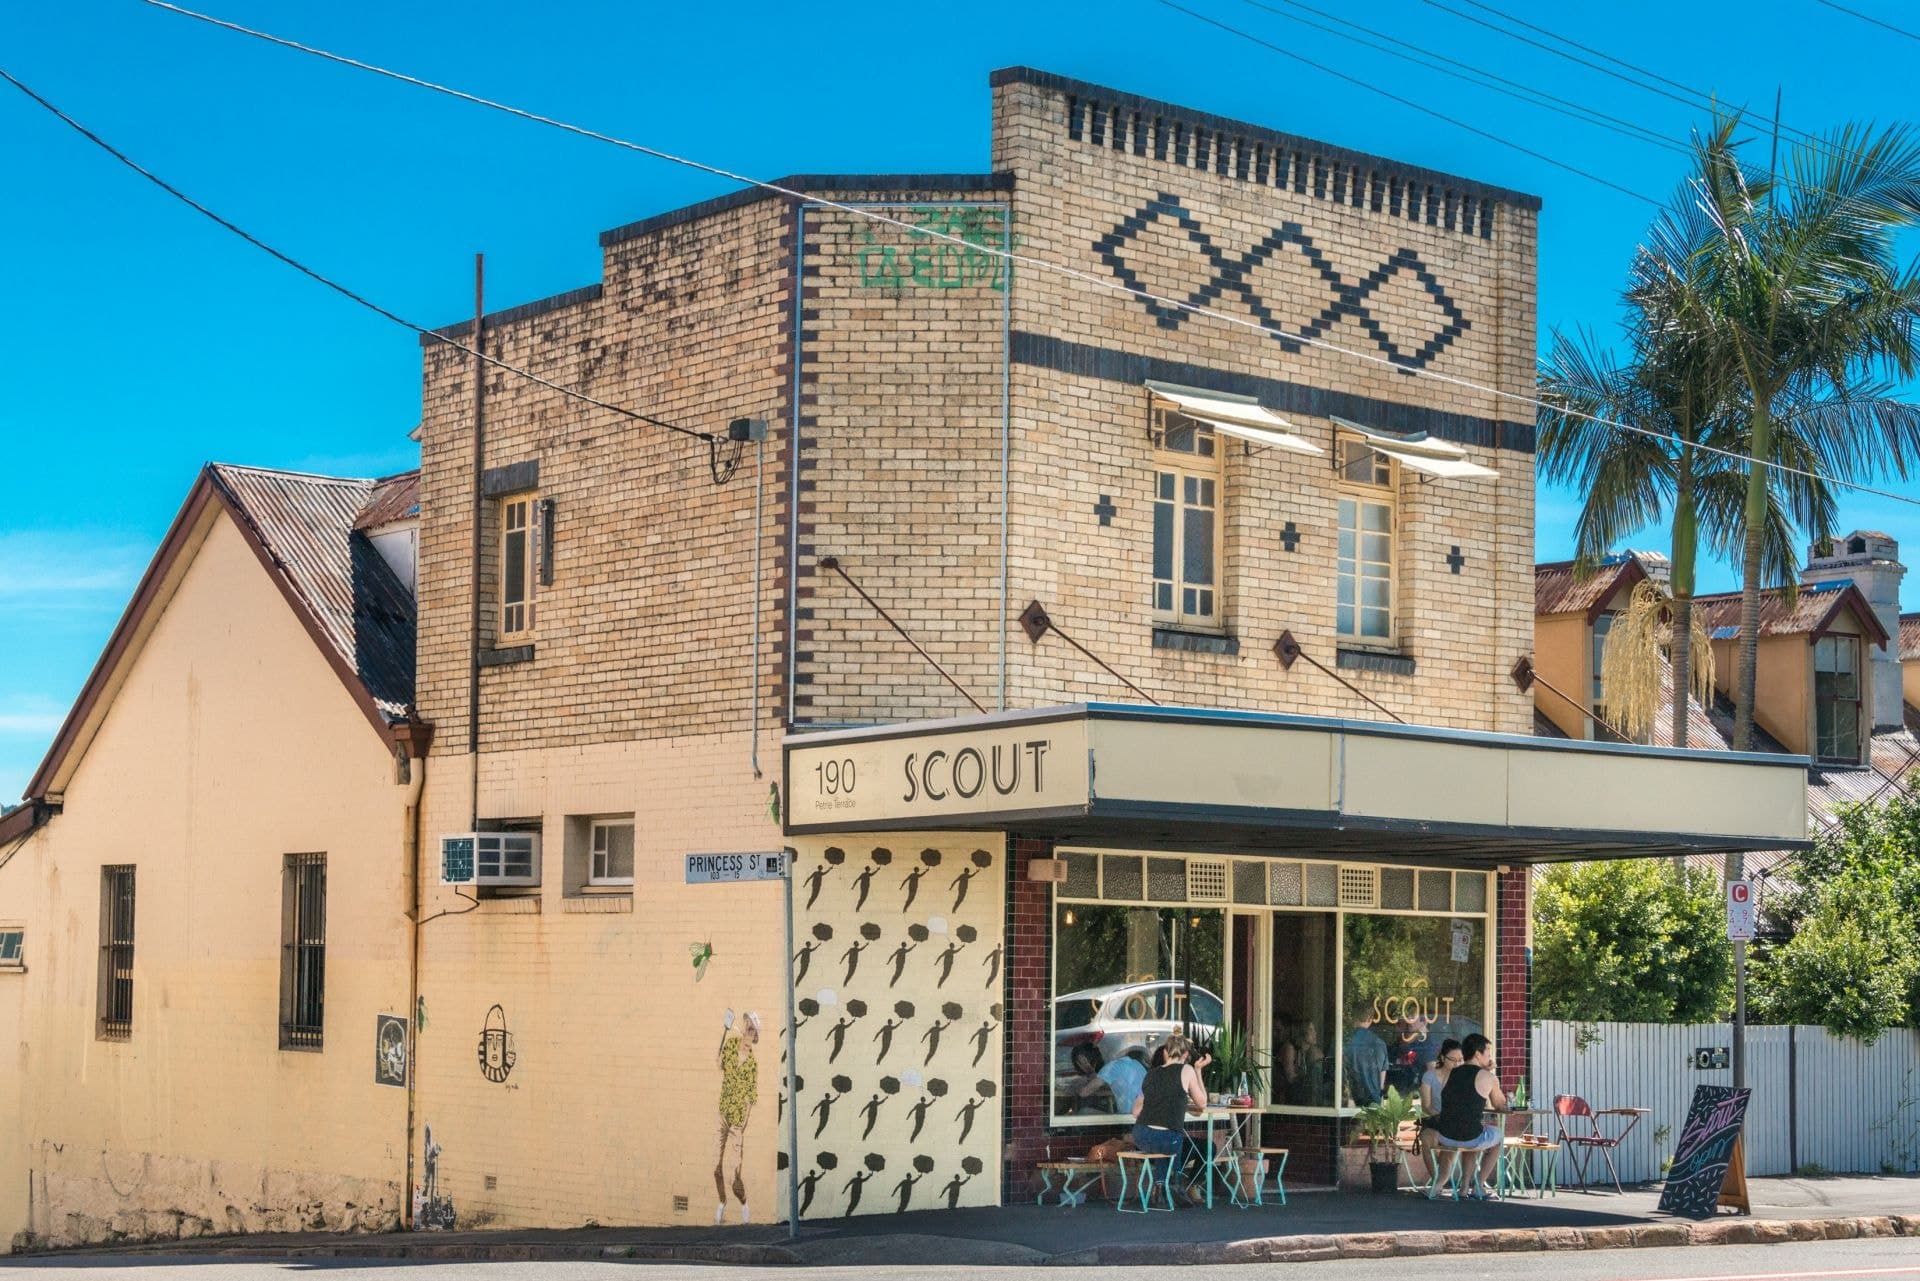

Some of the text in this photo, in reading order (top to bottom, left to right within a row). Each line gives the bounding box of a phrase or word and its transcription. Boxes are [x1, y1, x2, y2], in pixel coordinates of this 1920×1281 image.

[815, 758, 856, 795] 190
[903, 740, 1051, 802] SCOUT
[689, 854, 761, 872] PRINCESS ST
[1735, 885, 1746, 902] C
[1373, 996, 1455, 1024] SCOUT
